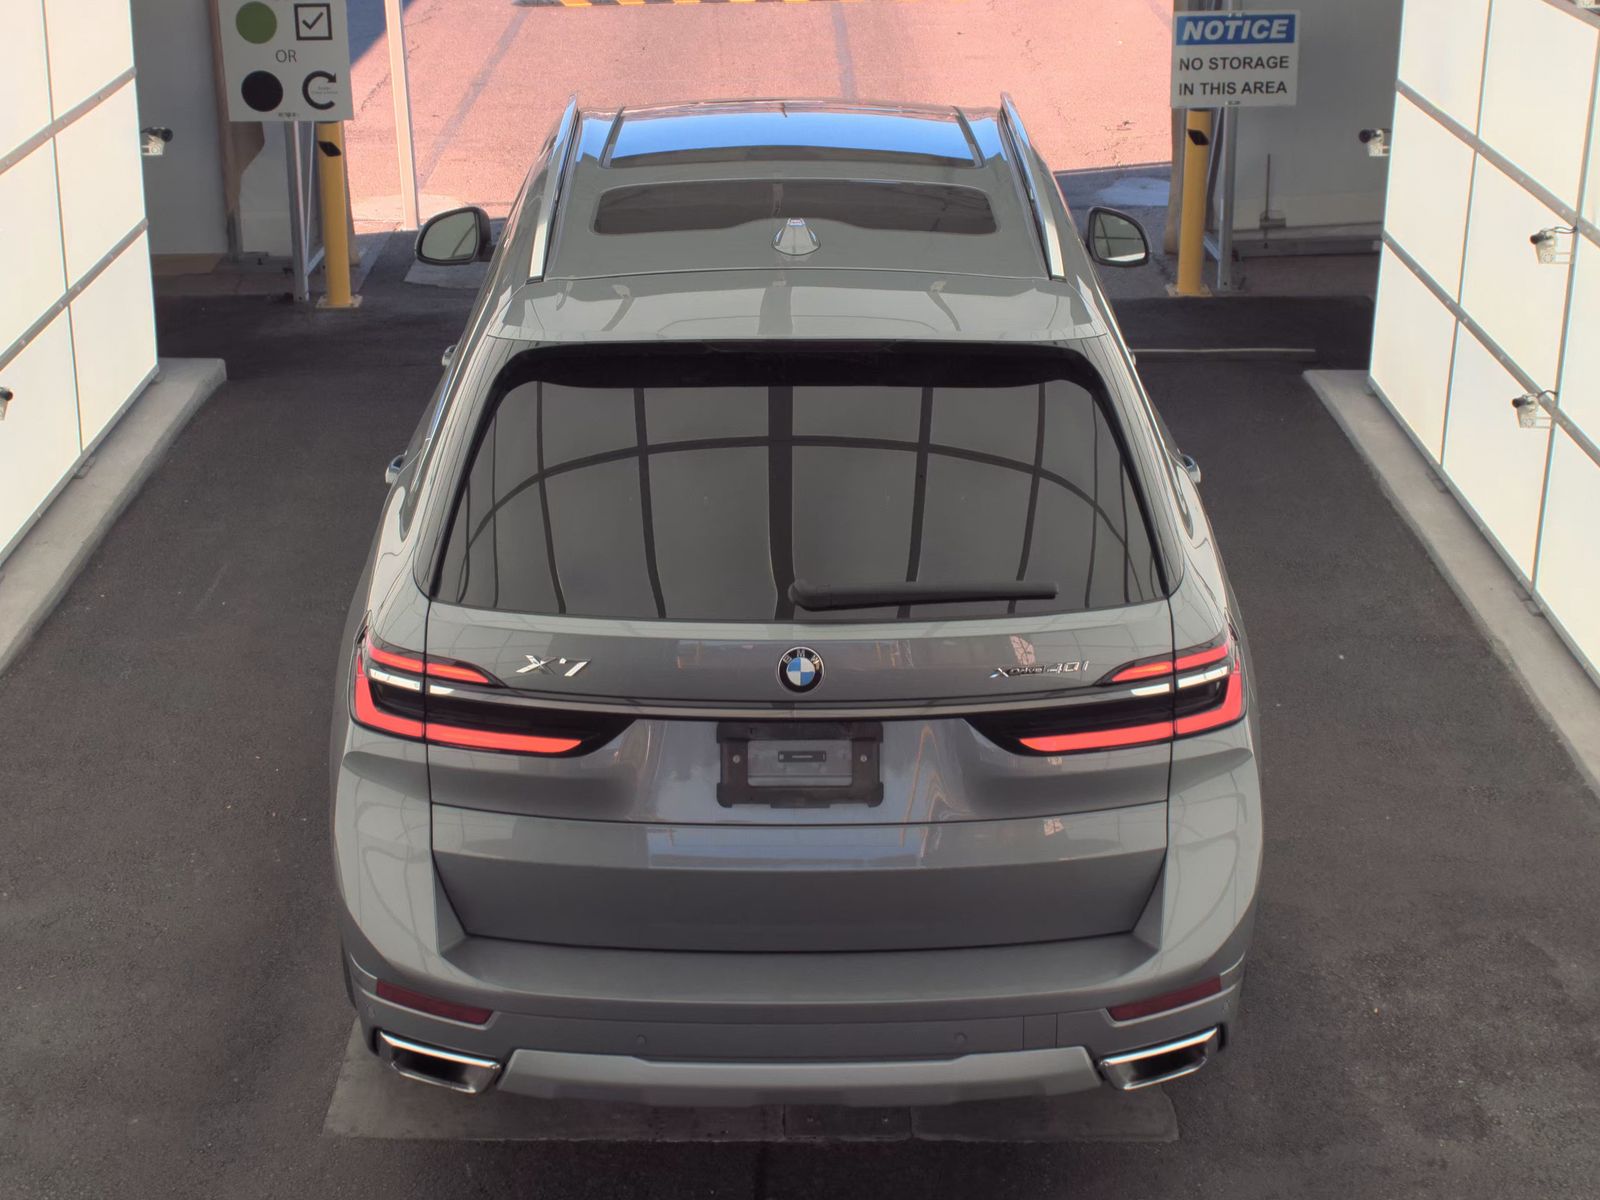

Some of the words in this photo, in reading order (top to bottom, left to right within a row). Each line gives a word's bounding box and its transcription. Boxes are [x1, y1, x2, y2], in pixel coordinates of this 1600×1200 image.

[1183, 19, 1289, 41] NOTICE
[275, 49, 297, 62] OR
[1179, 57, 1203, 71] NO
[1208, 56, 1289, 70] STORAGE
[1179, 83, 1194, 95] IN
[1200, 81, 1237, 95] THIS
[1241, 81, 1287, 94] AREA
[515, 654, 592, 677] X7
[782, 649, 820, 671] BMW
